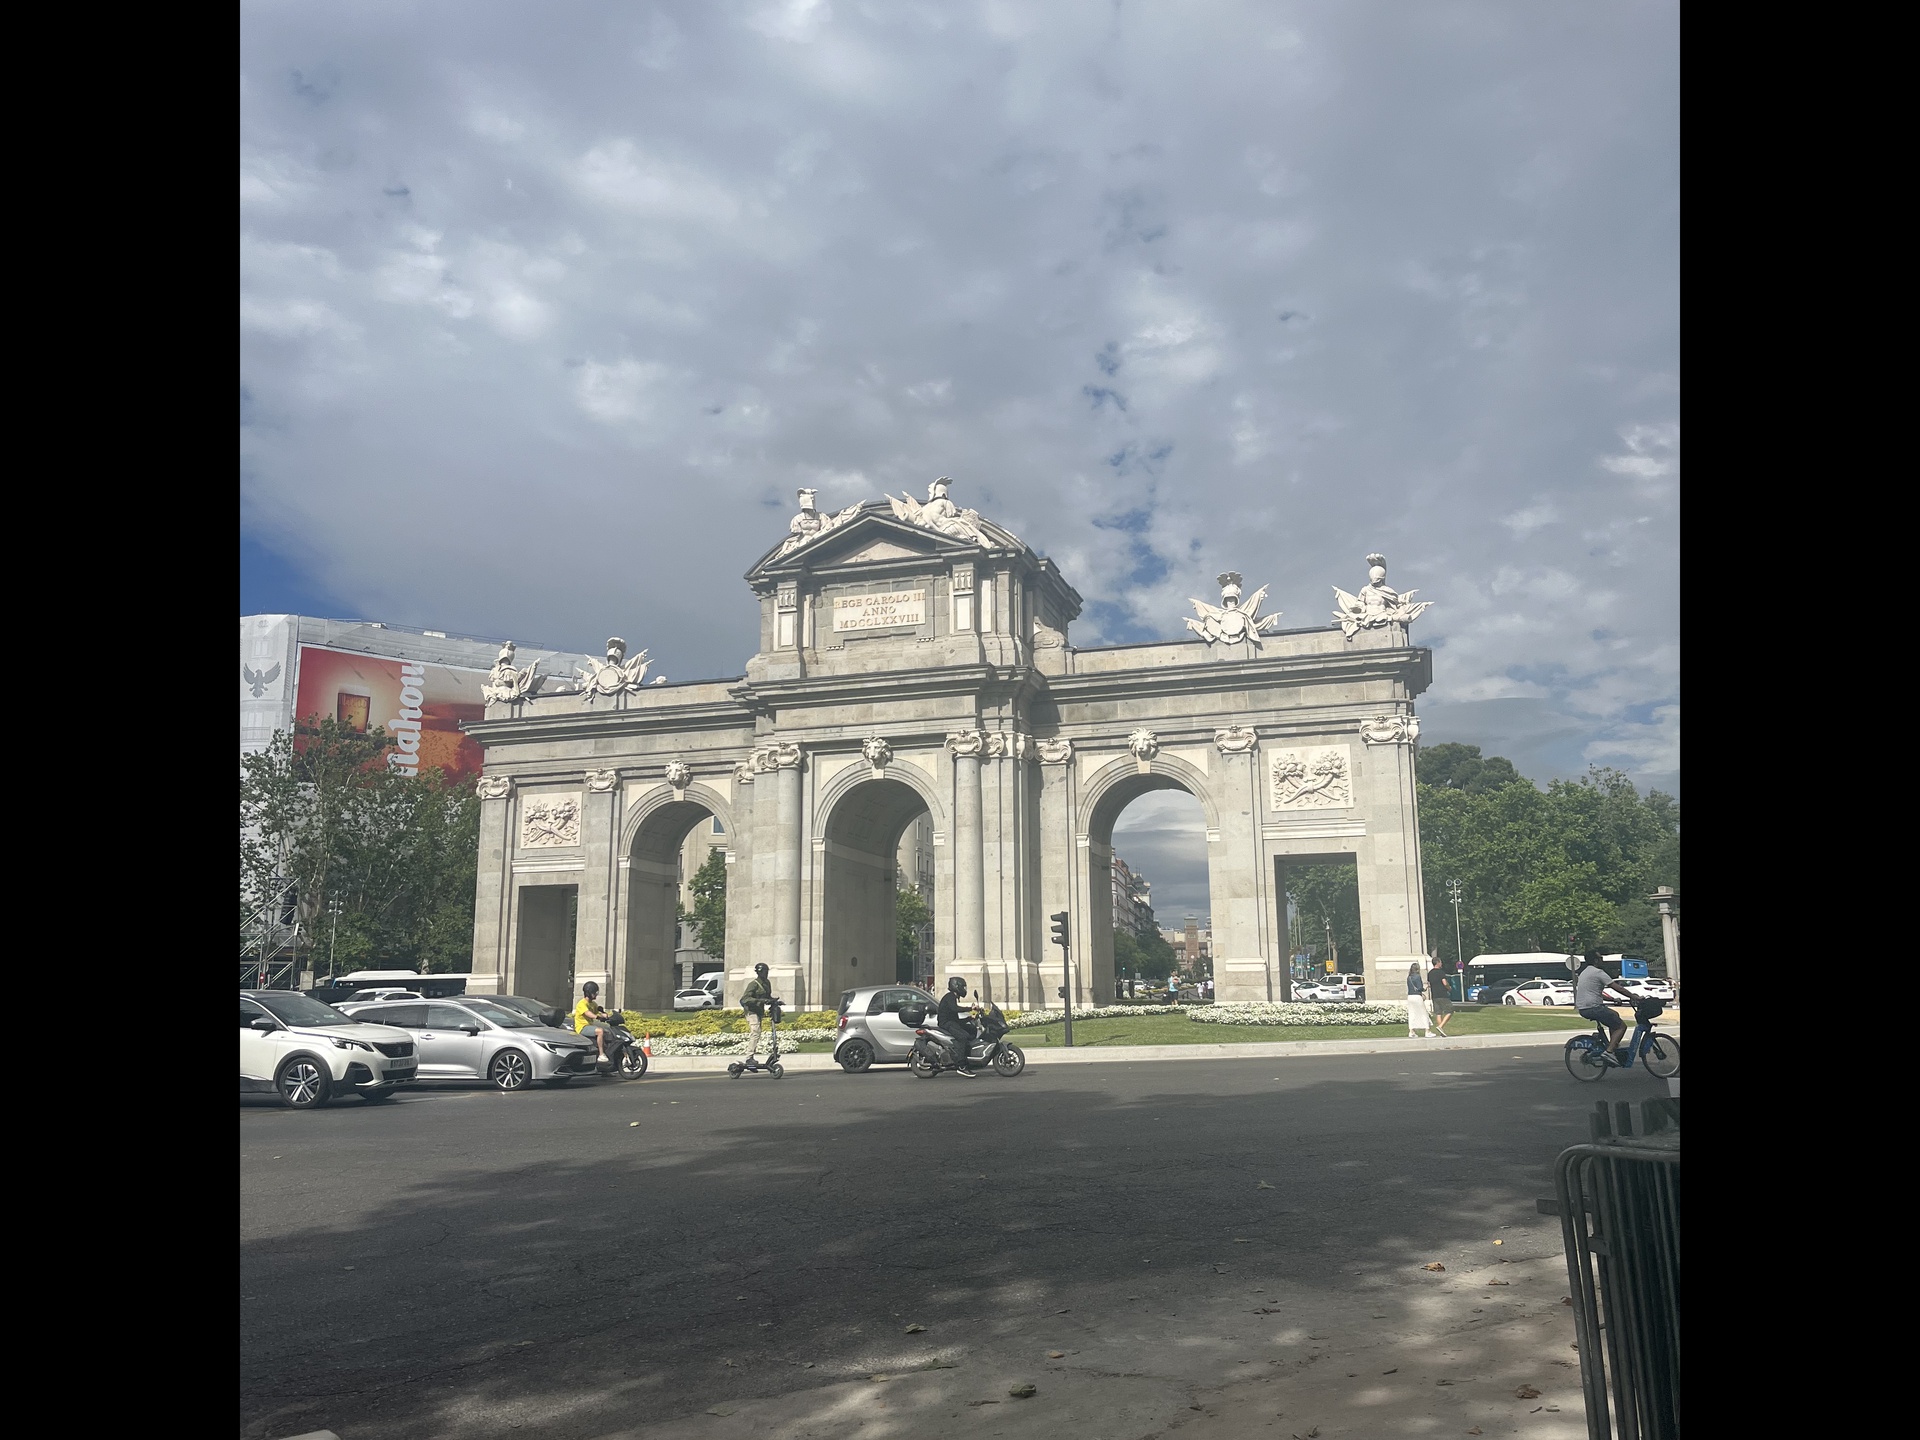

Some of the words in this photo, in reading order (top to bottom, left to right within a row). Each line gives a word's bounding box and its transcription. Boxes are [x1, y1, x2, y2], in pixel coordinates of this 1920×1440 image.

[866, 594, 910, 606] CAROLO
[862, 606, 896, 616] ANNO
[840, 614, 919, 629] MDCCLXXVIII
